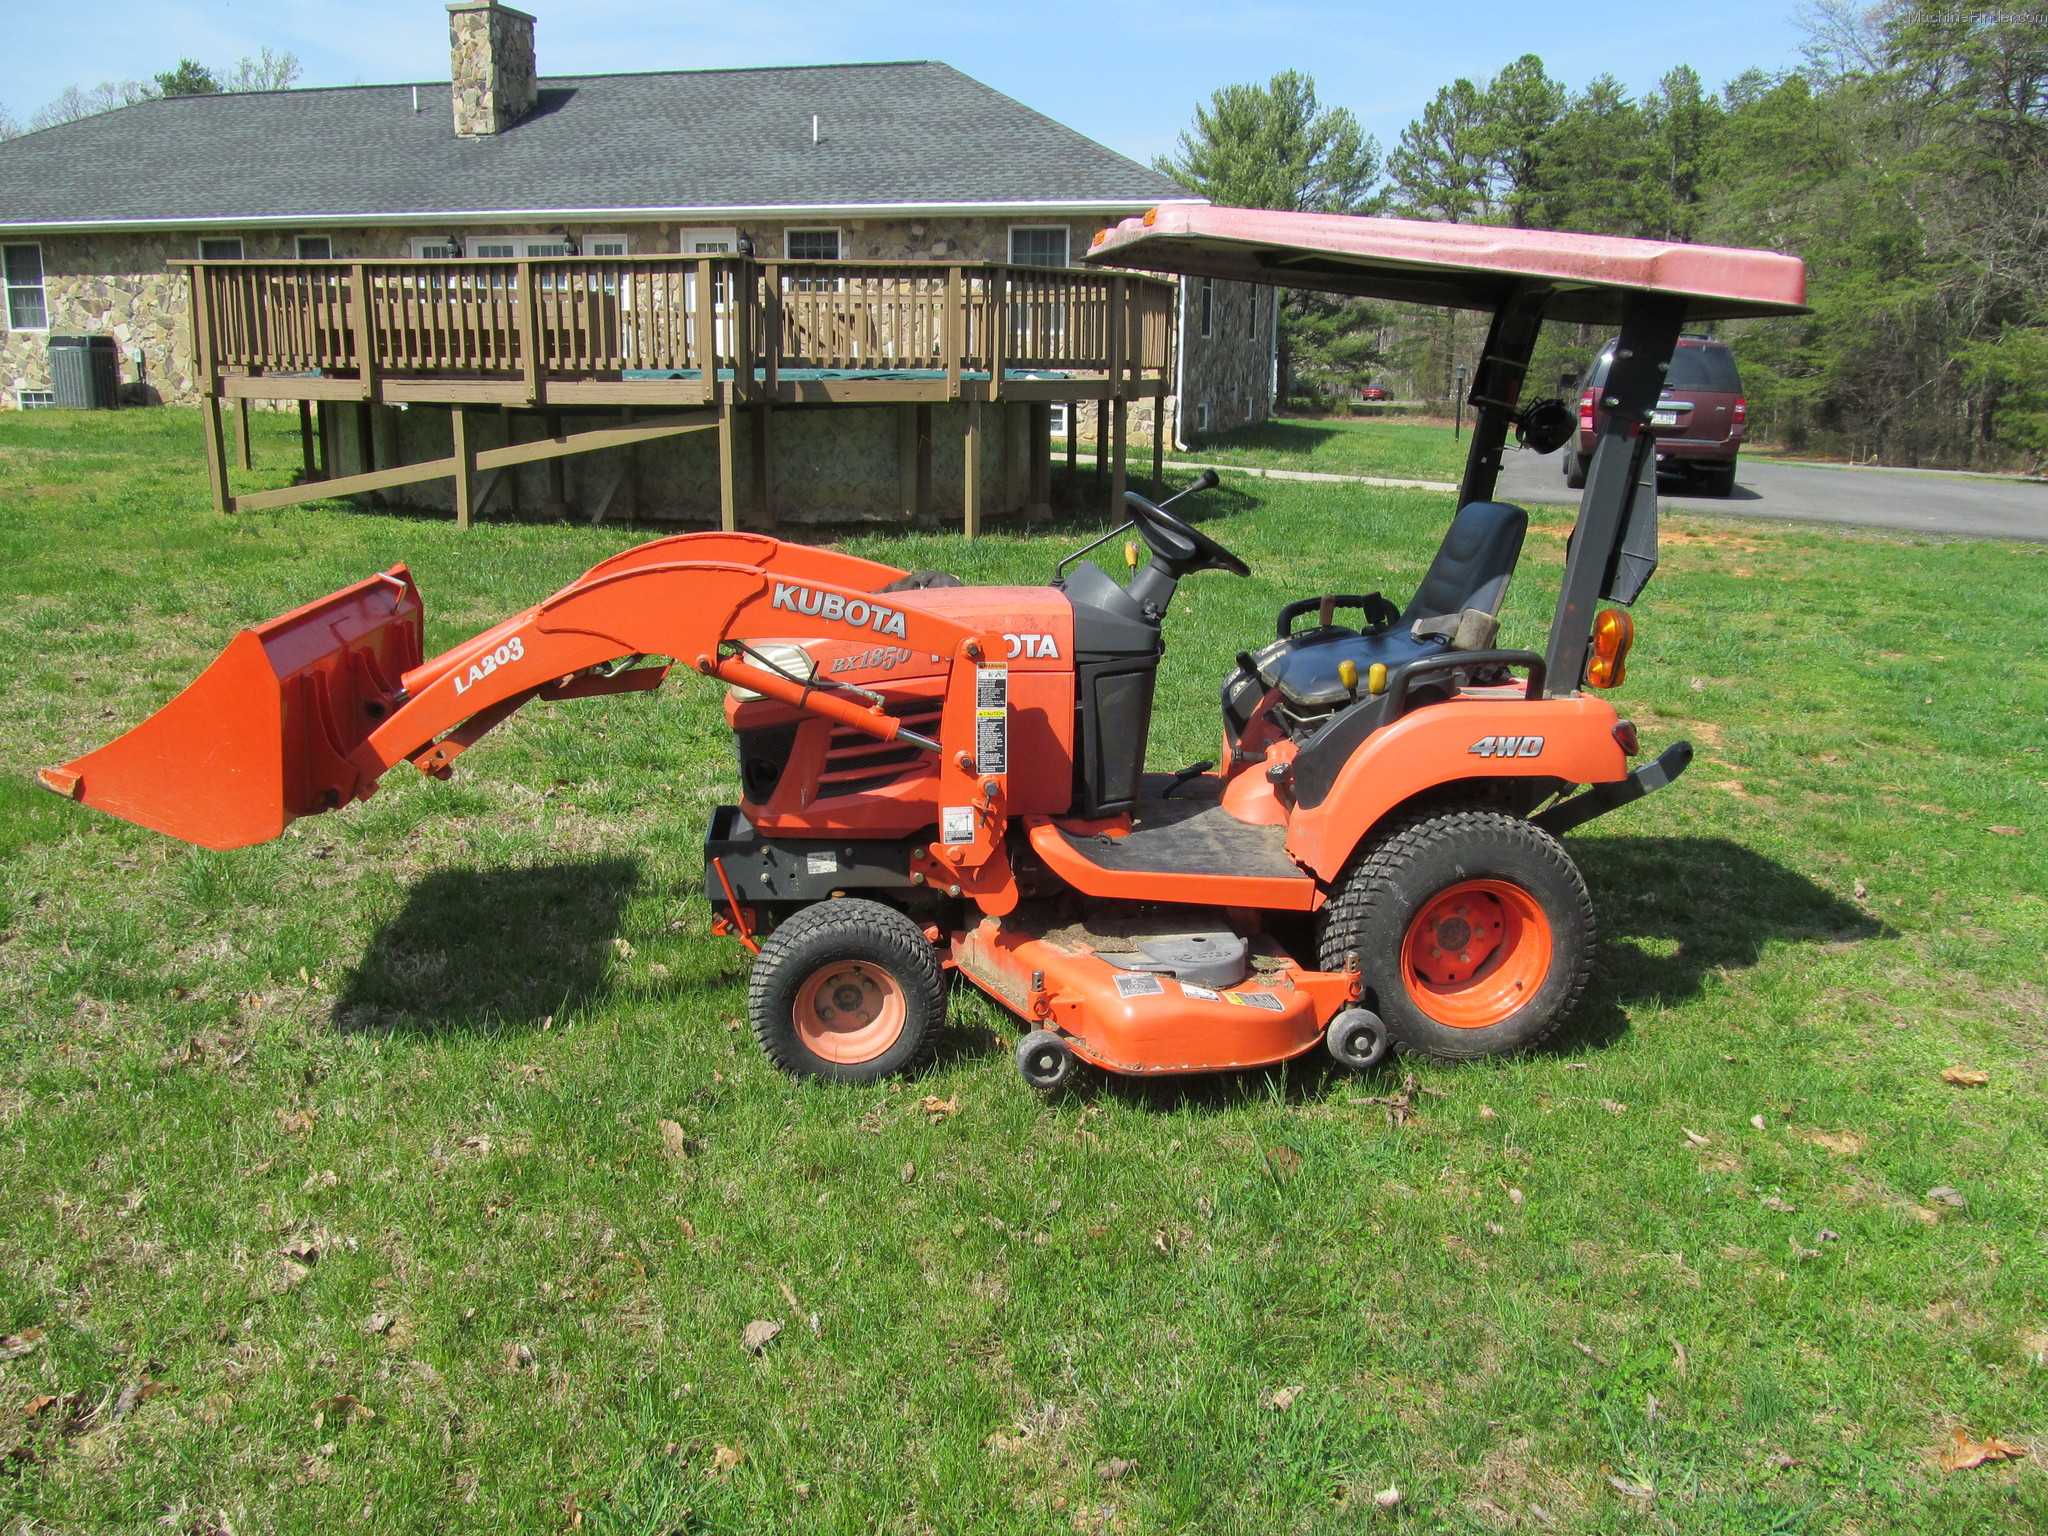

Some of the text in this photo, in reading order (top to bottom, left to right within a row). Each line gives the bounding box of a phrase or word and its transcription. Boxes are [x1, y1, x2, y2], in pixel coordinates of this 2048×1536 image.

[772, 582, 906, 639] KUBOTA
[454, 637, 525, 696] LA203
[831, 646, 912, 673] BX1850
[1469, 736, 1545, 758] 4WD
